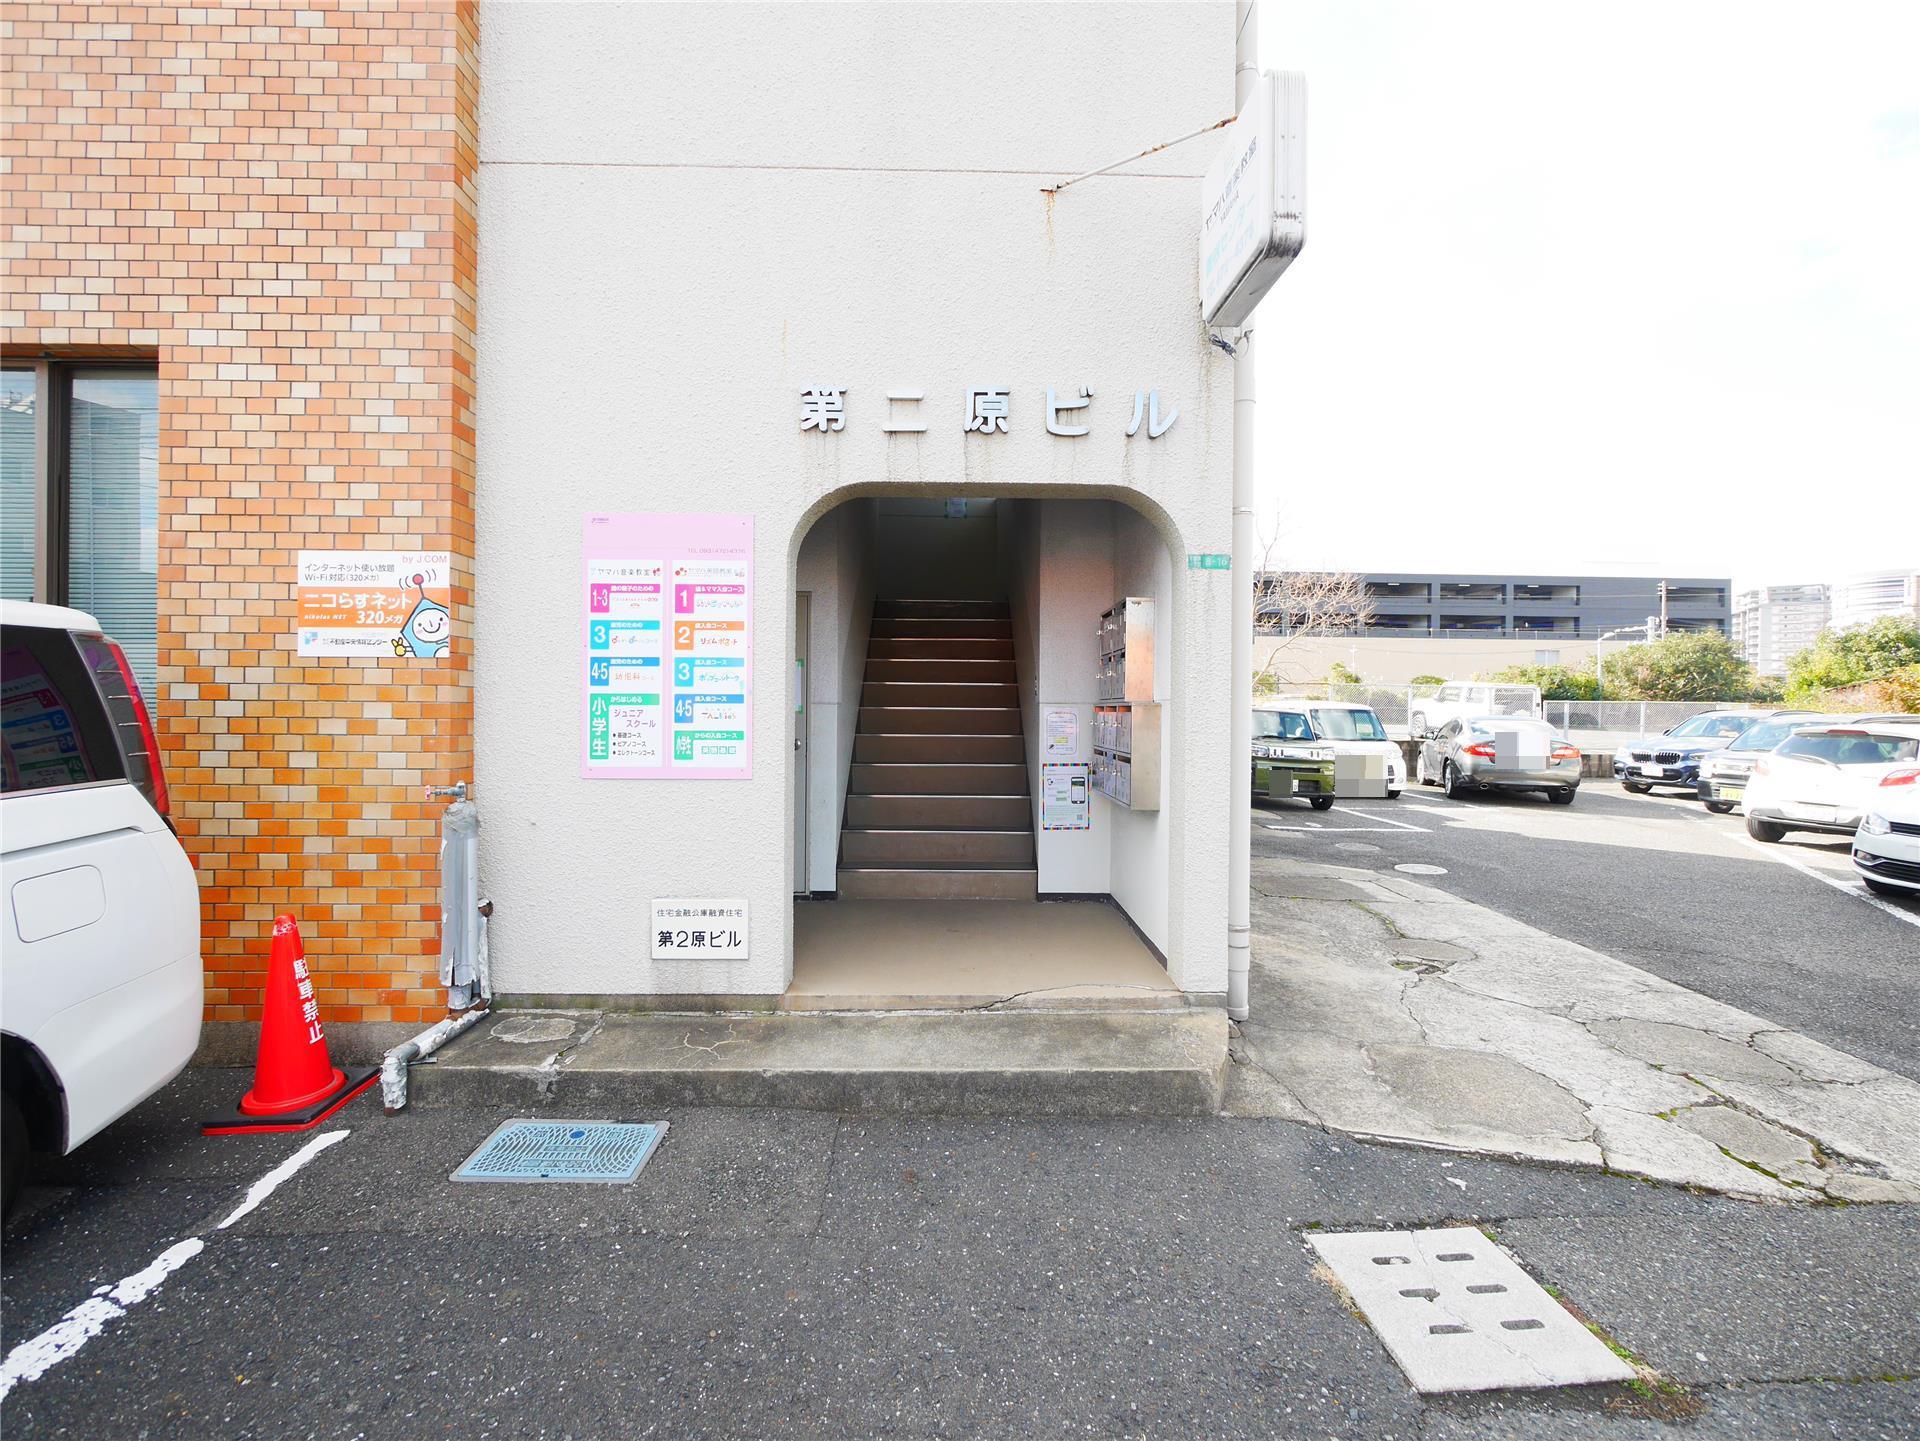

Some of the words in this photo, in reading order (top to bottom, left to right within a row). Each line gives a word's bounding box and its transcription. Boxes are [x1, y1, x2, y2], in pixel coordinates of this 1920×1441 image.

[799, 384, 1179, 438] 第二原ビル
[403, 555, 414, 564] by
[304, 564, 395, 573] インターネット使い放題
[304, 574, 328, 582] Wi-Fi
[304, 593, 412, 610] ニコらすネット
[679, 590, 688, 607] 1
[356, 611, 404, 624] 320メガ
[594, 626, 606, 643] 3
[678, 626, 691, 643] 2
[678, 663, 691, 680] 3
[614, 708, 644, 718] ジュニア
[591, 697, 608, 757] 小学生
[626, 719, 657, 729] スクール
[657, 909, 743, 918] 住宅金融公庫融資住宅
[657, 930, 742, 948] 第2原ビル
[293, 957, 324, 1044] 駐車禁止
